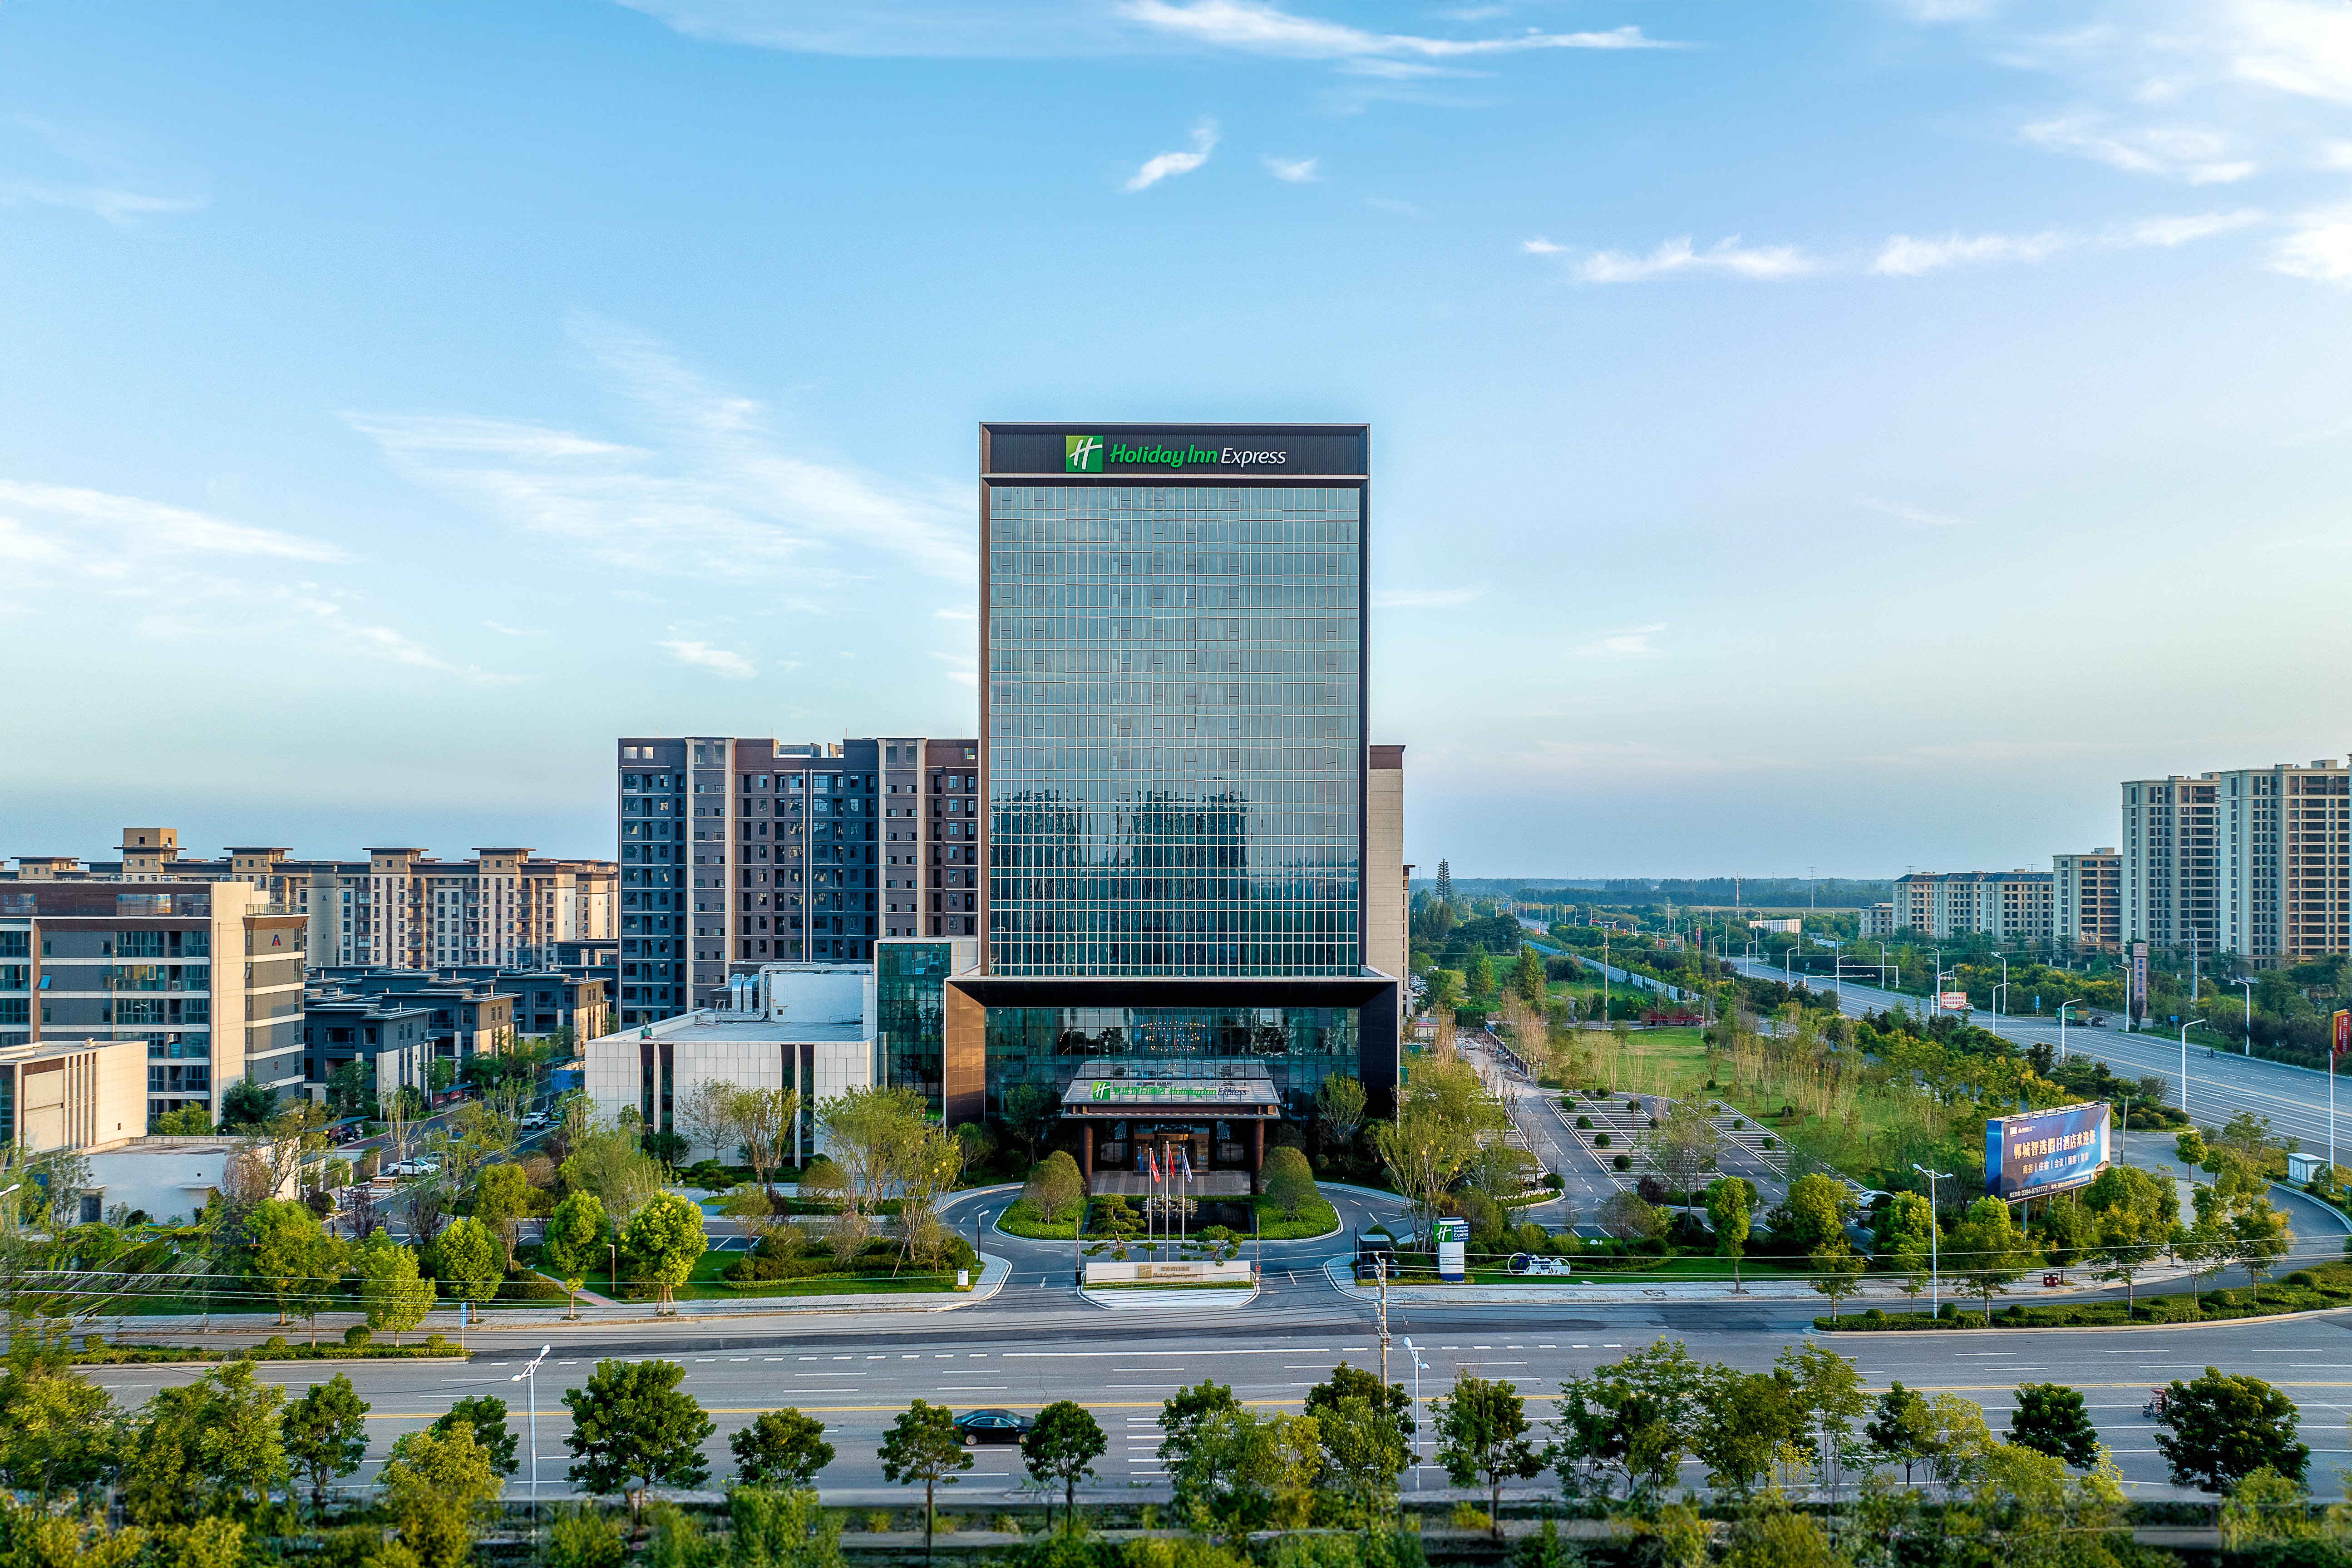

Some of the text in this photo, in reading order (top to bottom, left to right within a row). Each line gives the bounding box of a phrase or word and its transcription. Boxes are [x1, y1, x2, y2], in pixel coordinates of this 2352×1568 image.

[1109, 444, 1287, 468] Holiday Inn Express
[1169, 1087, 1247, 1097] Holiday Inn Express
[2022, 1164, 2034, 1174] 商务
[2038, 1160, 2050, 1172] 住宿
[2054, 1158, 2064, 1169] 会议
